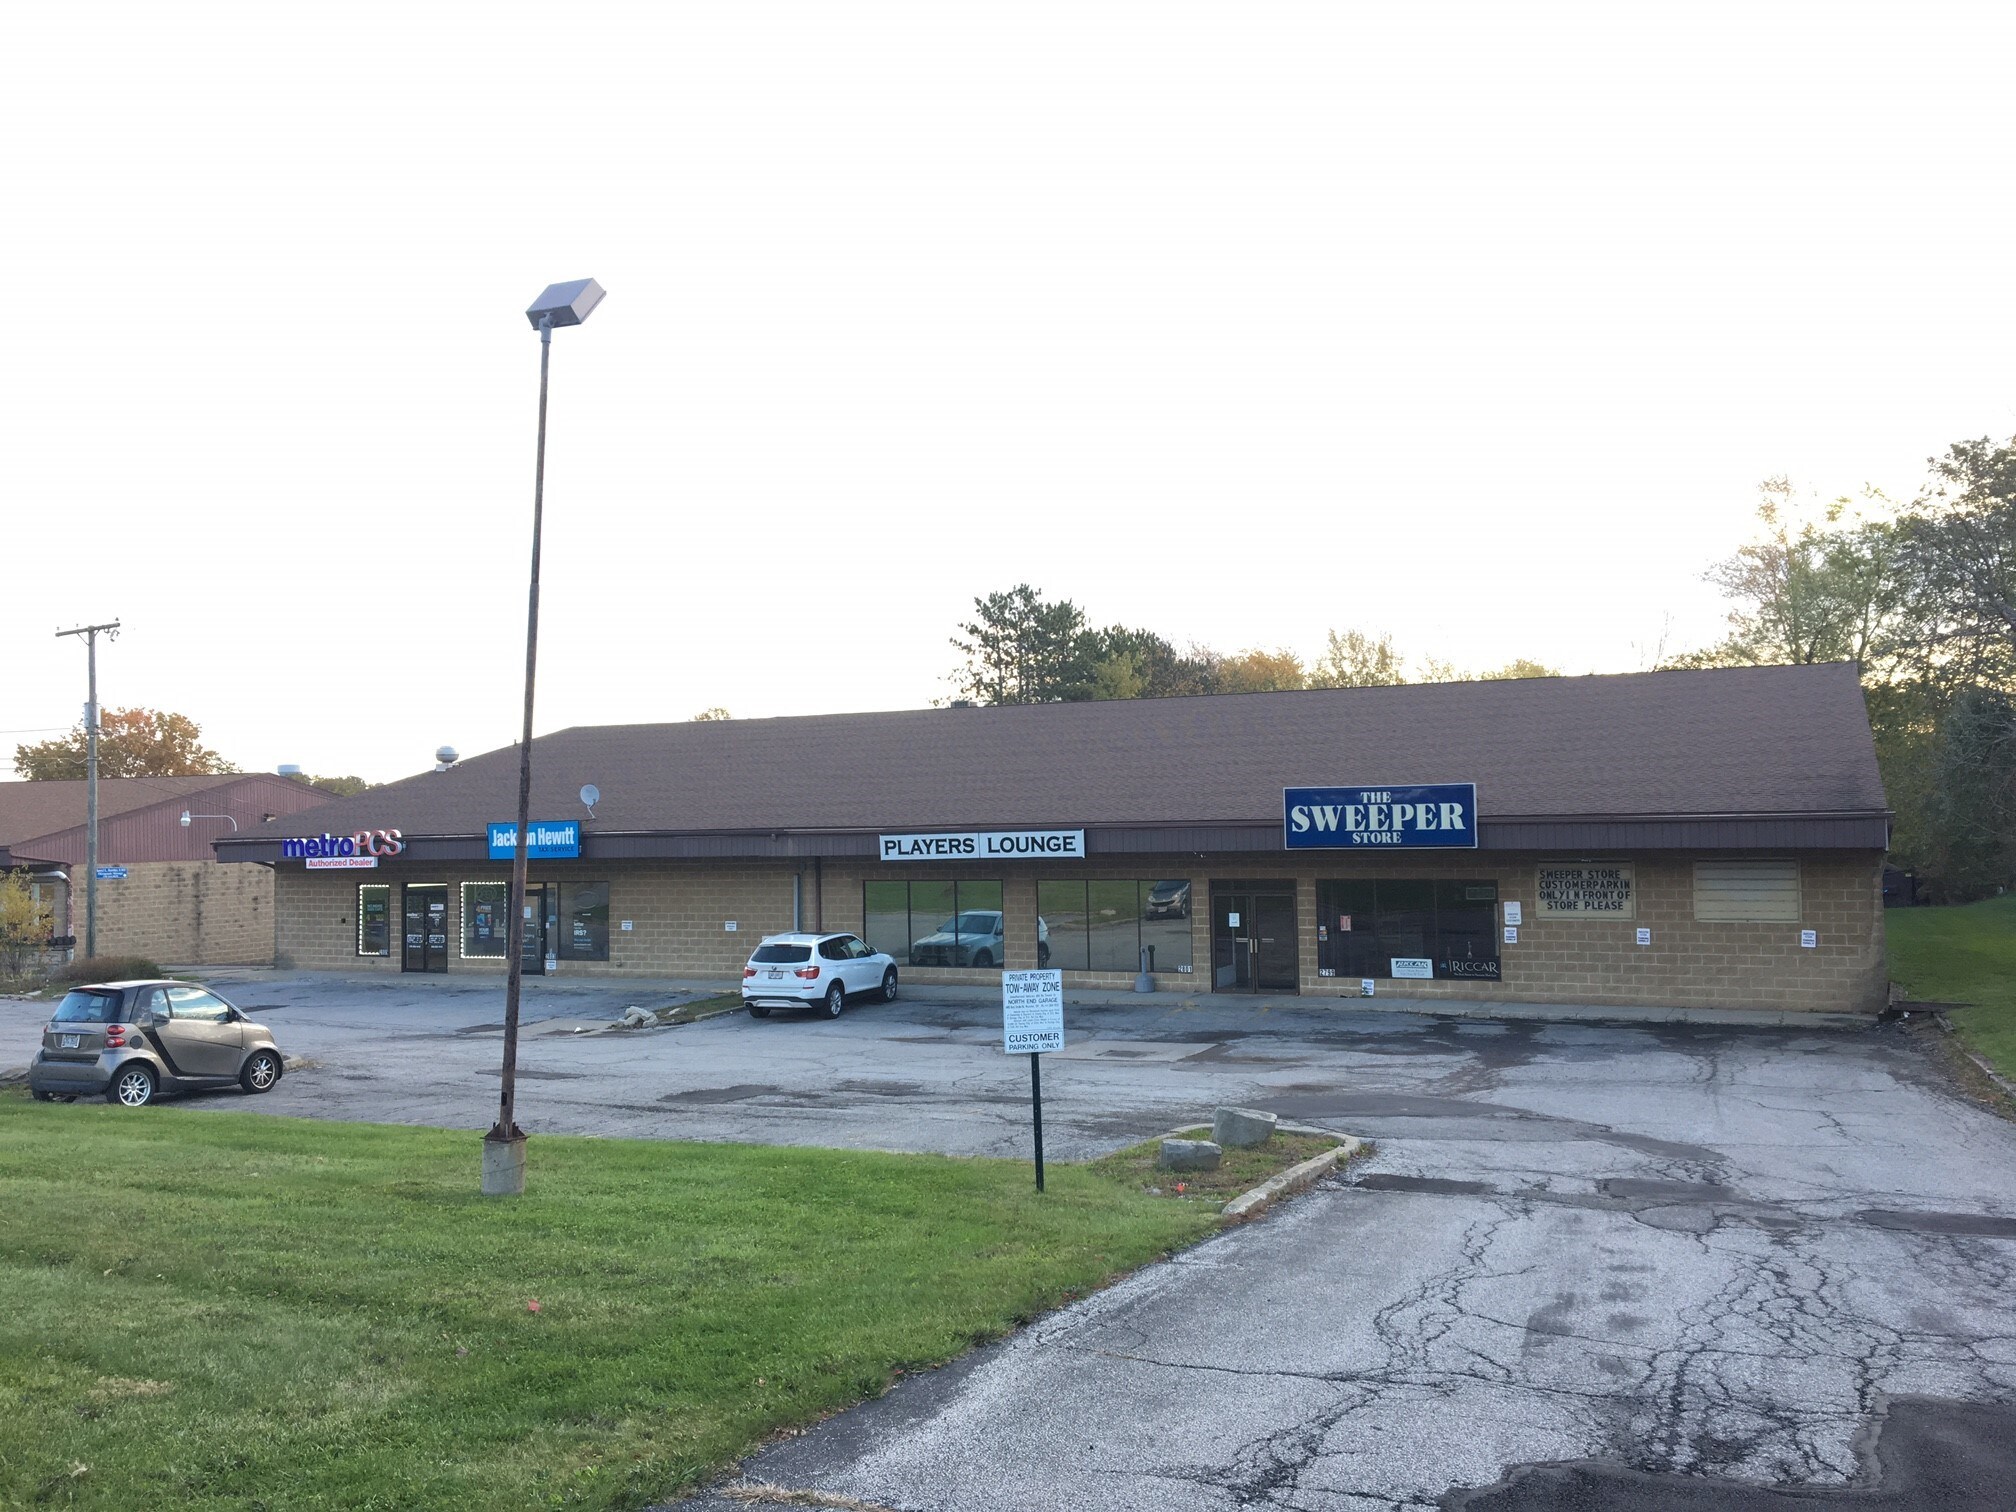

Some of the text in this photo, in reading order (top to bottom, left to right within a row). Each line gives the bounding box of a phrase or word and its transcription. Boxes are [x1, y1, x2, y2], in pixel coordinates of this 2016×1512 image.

[1360, 791, 1391, 804] THE
[1291, 802, 1466, 832] SWEEPER
[537, 827, 575, 846] Hewitt
[1352, 831, 1402, 844] STORE
[282, 829, 402, 858] metroPCS
[884, 835, 1077, 856] PLAYERS LOUNGE
[308, 858, 373, 868] Authorized Dealer
[1539, 870, 1621, 879] SWEEPER STORE
[1583, 890, 1615, 900] FRONT
[1617, 890, 1631, 900] OF
[1547, 900, 1624, 910] STORE PLEASE
[1452, 960, 1499, 974] RICCAR
[1009, 973, 1055, 982] PRIVATE PROPERTY
[1005, 981, 1060, 993] TOW-AWAY ZONE
[1009, 1033, 1060, 1043] CUSTOMER
[1009, 1042, 1060, 1051] PARKING ONLY
